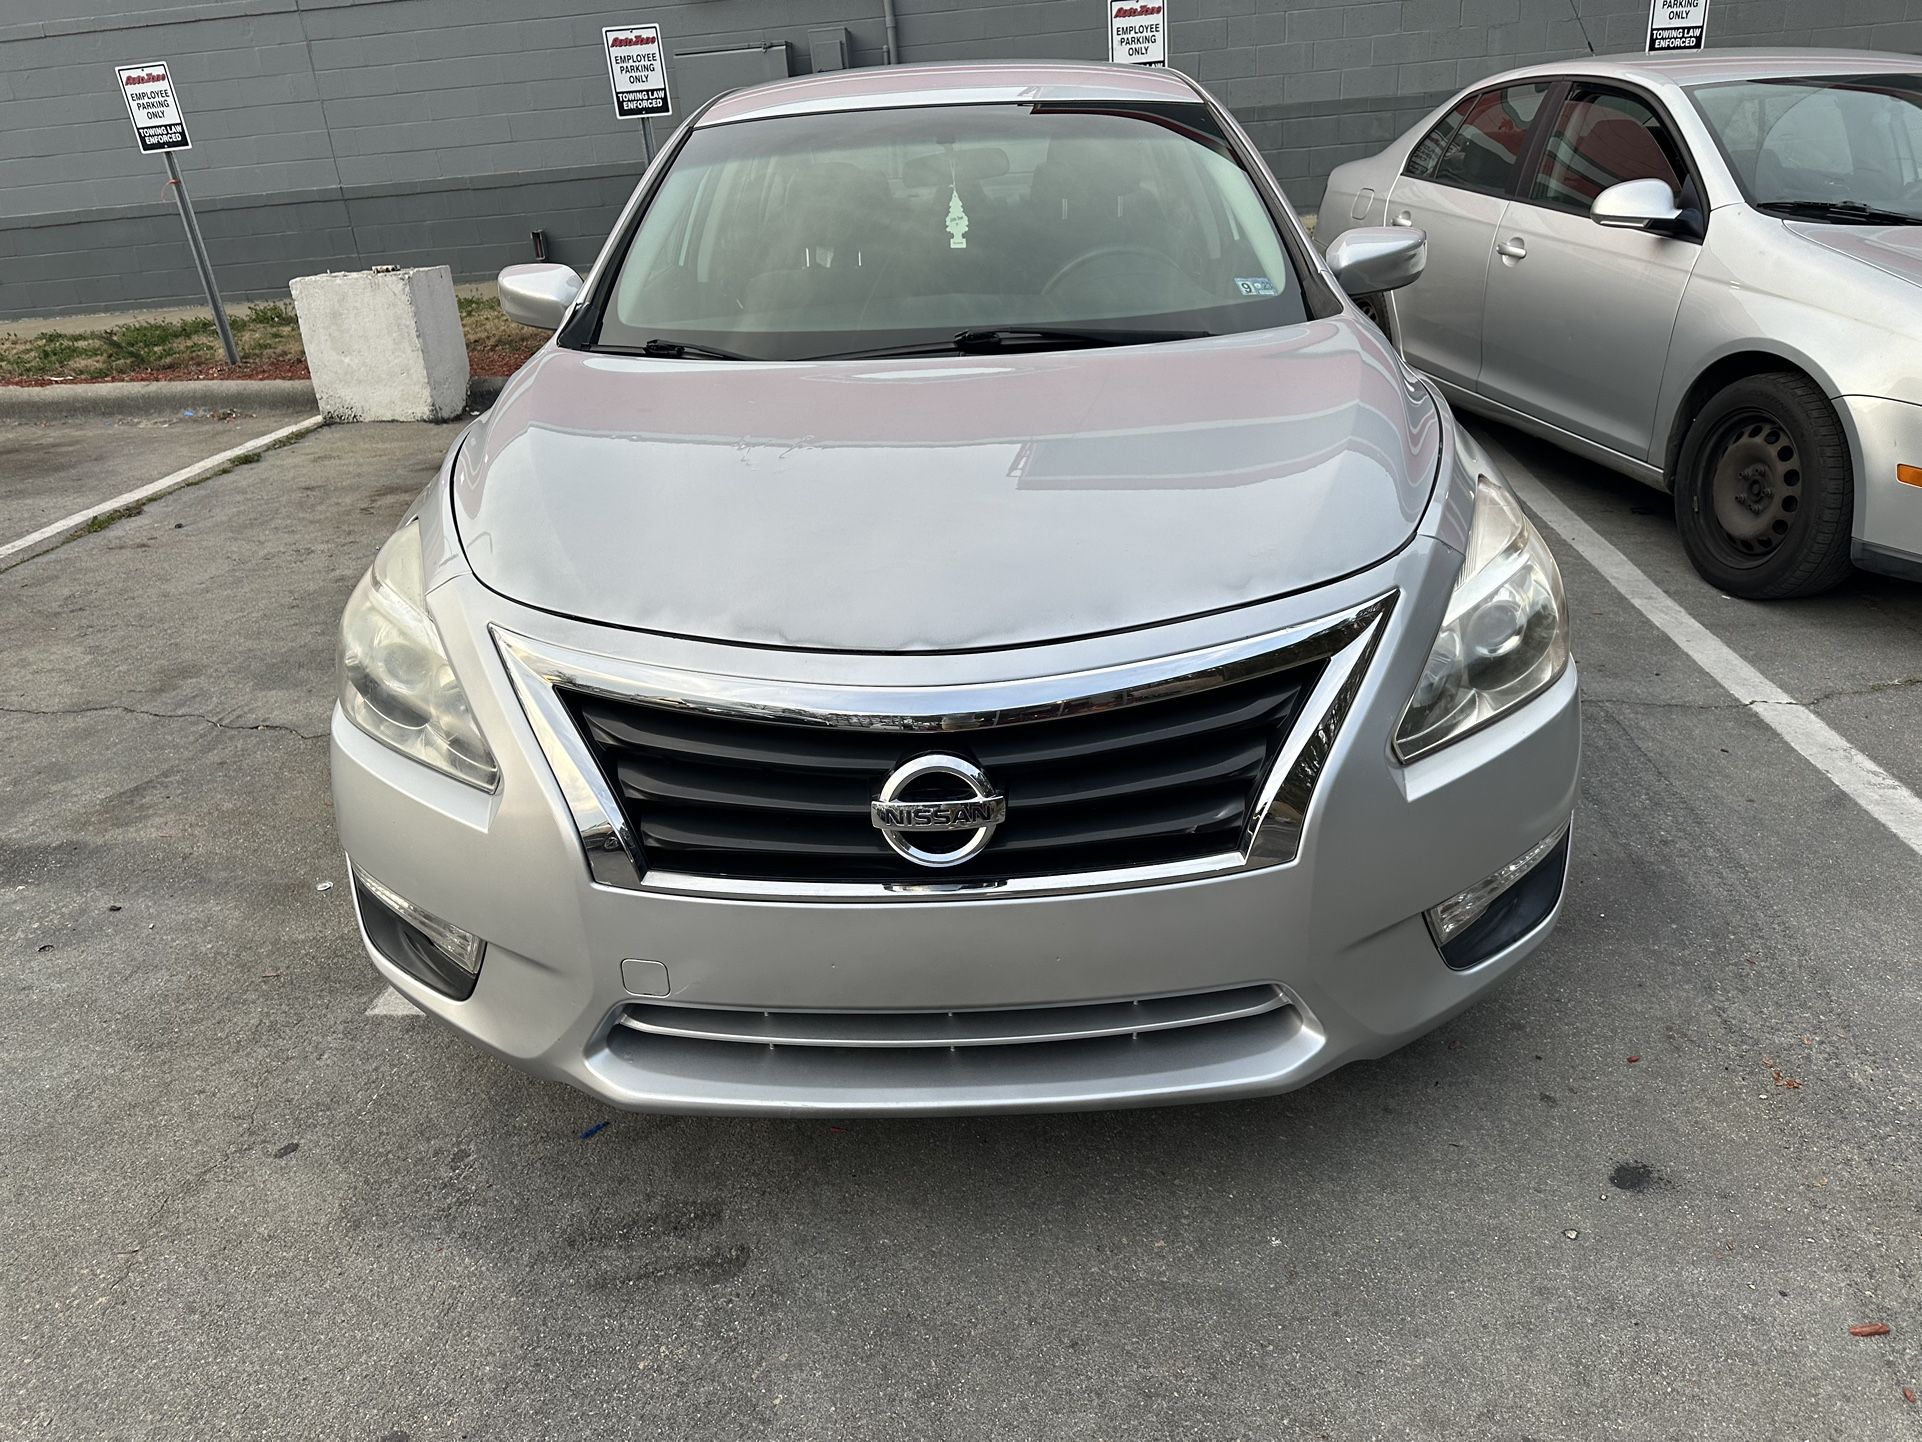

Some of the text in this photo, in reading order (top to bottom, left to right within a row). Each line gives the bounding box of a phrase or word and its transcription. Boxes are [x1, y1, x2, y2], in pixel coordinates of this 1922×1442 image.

[1662, 0, 1698, 9] PARKING
[1668, 10, 1690, 20] ONLY
[1116, 23, 1160, 36] EMPLOYEE
[1652, 28, 1701, 39] TOWING LAW
[1120, 34, 1156, 46] PARKING
[1655, 37, 1696, 48] ENFORCED
[1127, 46, 1149, 56] ONLY
[614, 53, 657, 64] EMPLOYEE
[620, 63, 655, 75] PARKING
[628, 74, 649, 84] ONLY
[130, 89, 170, 102] EMPLOYEE
[618, 90, 665, 102] TOWING LAW
[137, 99, 169, 111] PARKING
[623, 99, 662, 110] ENFORCED
[146, 110, 165, 120] ONLY
[139, 124, 182, 137] TOWING LAW
[145, 133, 181, 145] ENFORCED
[1241, 282, 1253, 294] 9
[879, 804, 992, 827] NISSAN
